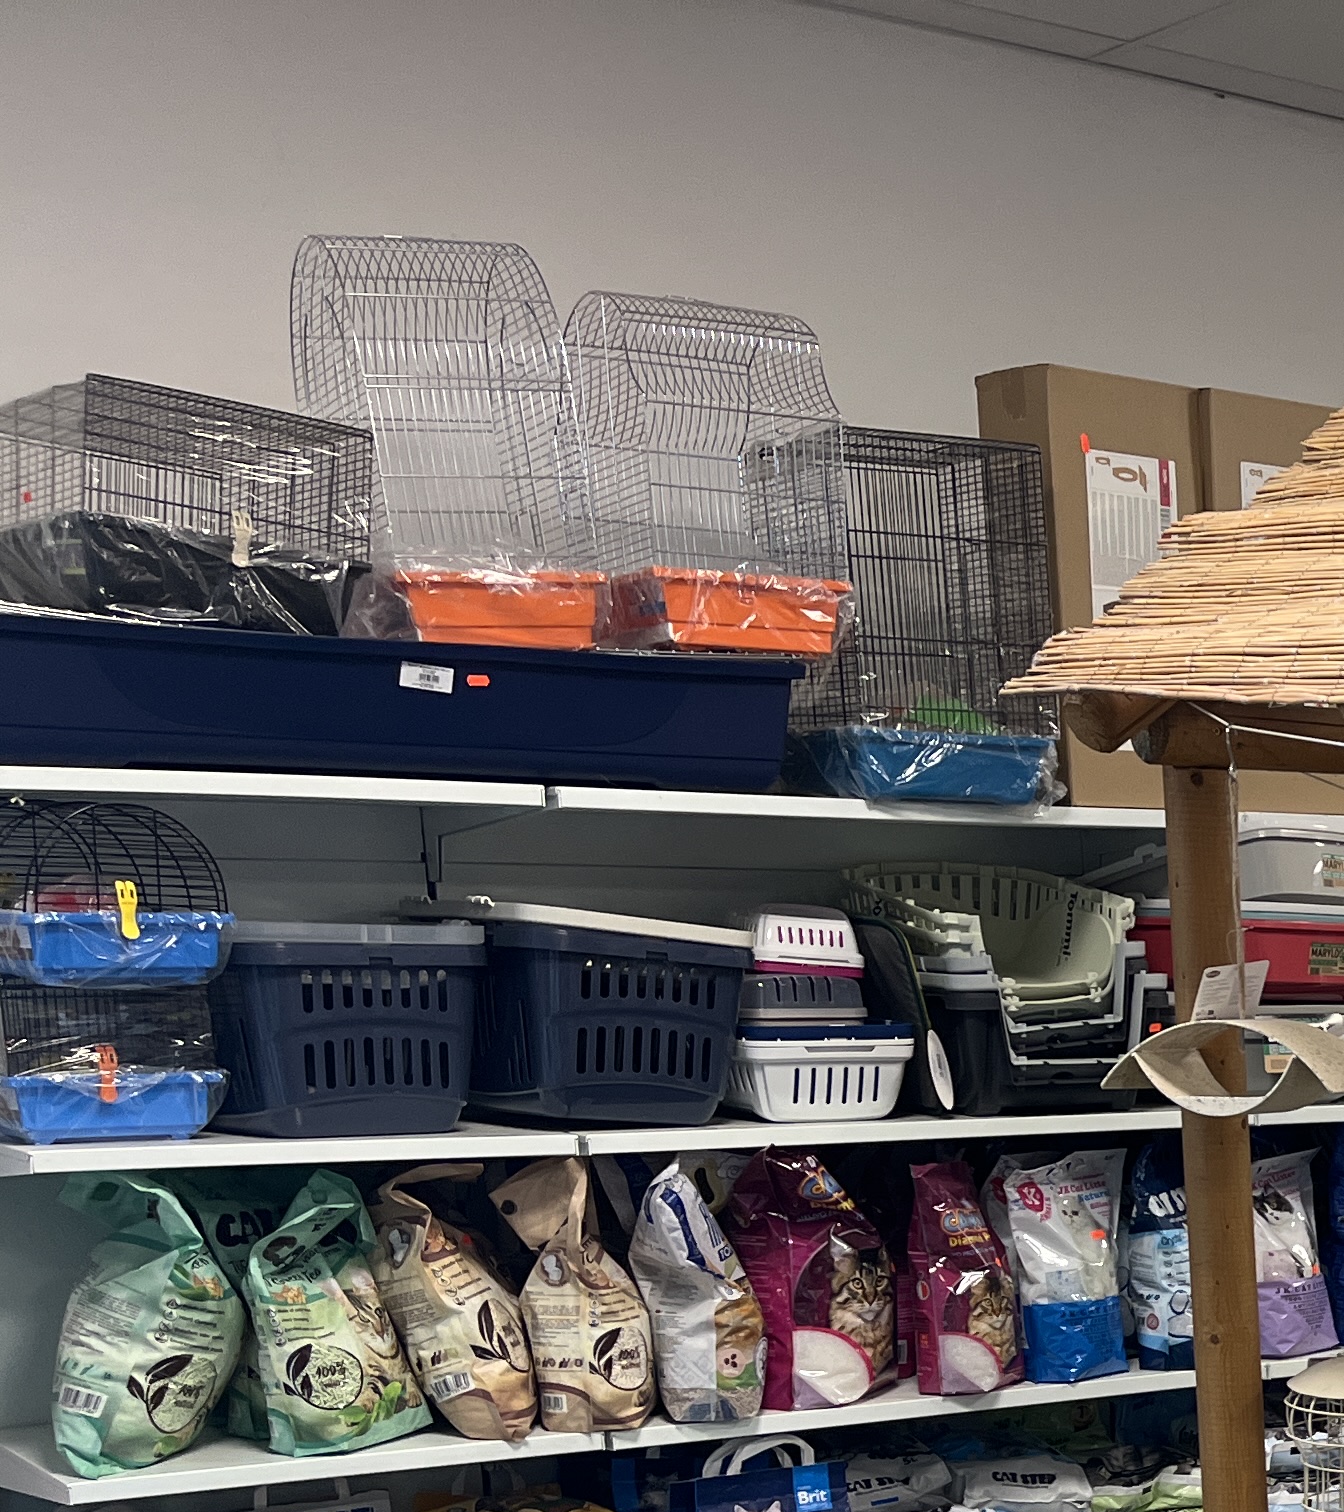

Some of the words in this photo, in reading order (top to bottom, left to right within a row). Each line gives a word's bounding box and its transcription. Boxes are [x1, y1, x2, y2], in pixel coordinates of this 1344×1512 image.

[992, 1471, 1021, 1484] CAT
[1022, 1473, 1057, 1484] STEP
[797, 1489, 828, 1505] Brit
